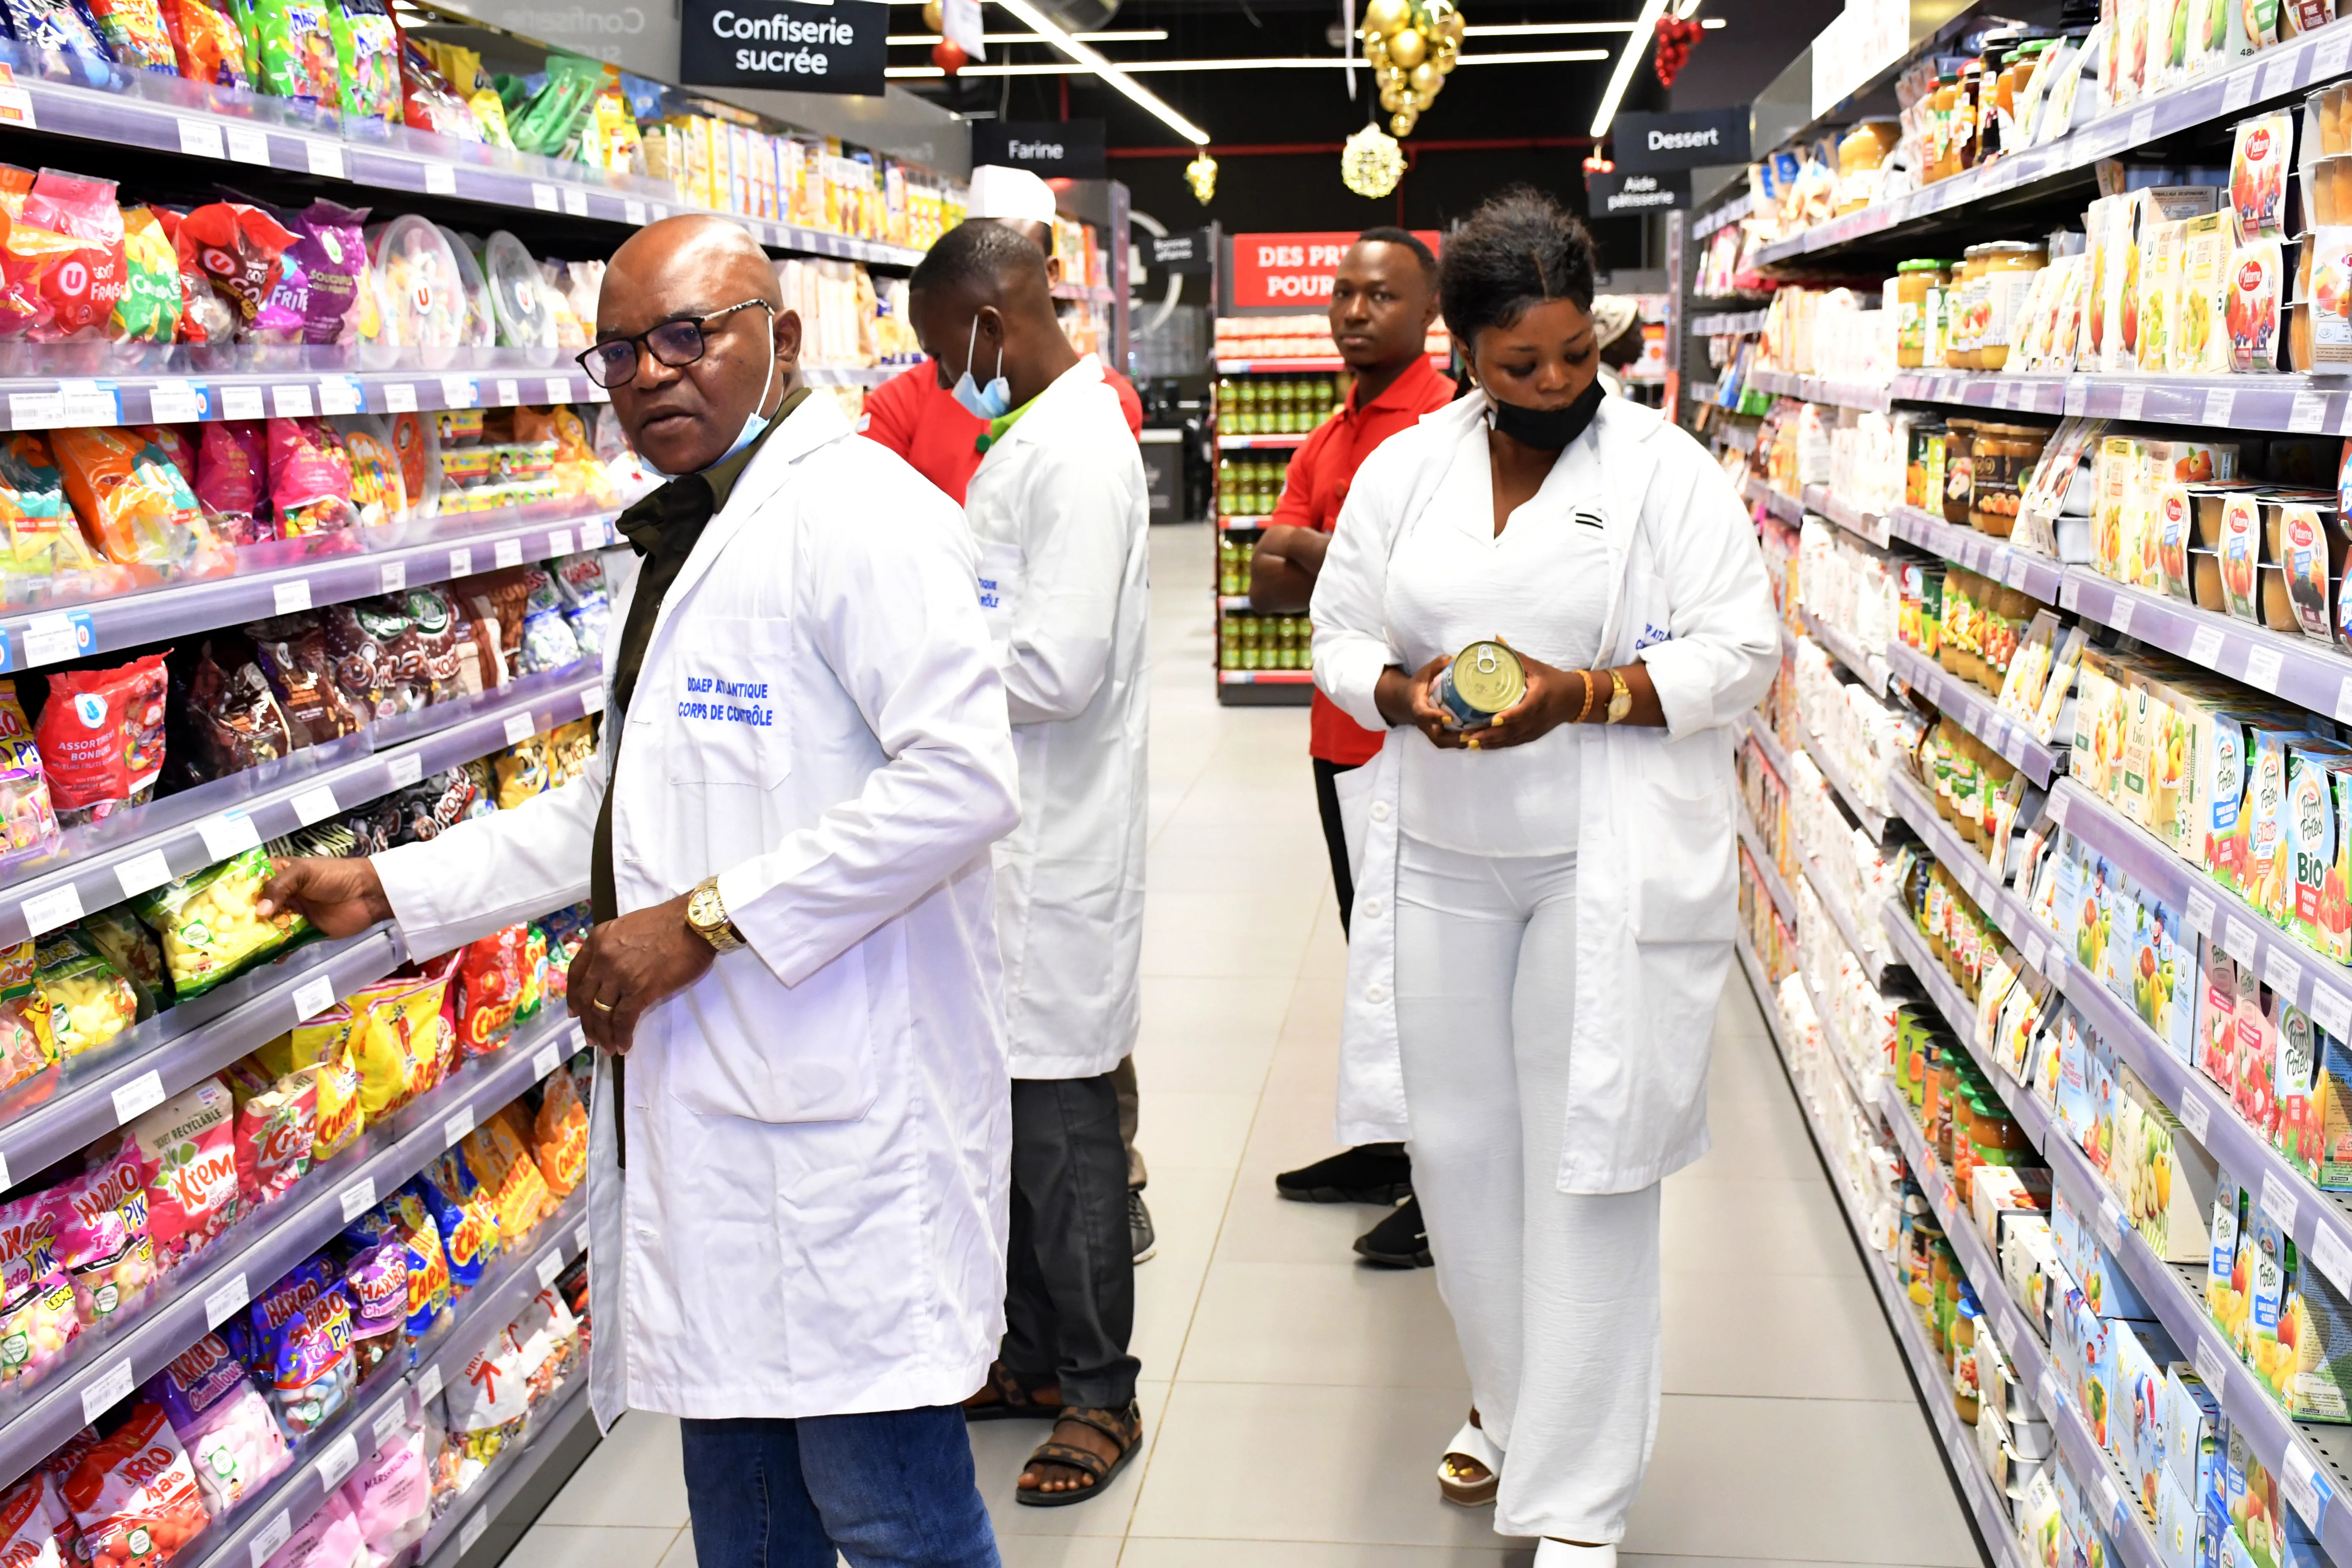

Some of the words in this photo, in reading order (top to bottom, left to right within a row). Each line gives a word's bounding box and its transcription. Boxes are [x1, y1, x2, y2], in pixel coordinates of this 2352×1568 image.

[713, 9, 854, 46] Confiserie
[736, 46, 828, 75] sucrée
[1008, 139, 1064, 159] Farine
[1648, 128, 1719, 151] Dessert
[1624, 175, 1657, 192] Aide
[1607, 189, 1675, 211] pâtisserie
[1258, 246, 1303, 268] DES
[65, 270, 82, 289] U
[1268, 275, 1335, 297] POUR
[418, 287, 428, 306] U
[79, 631, 87, 642] U
[687, 677, 712, 693] DDAEP
[715, 679, 768, 698] ATLANTIQUE
[678, 701, 707, 720] CORPS
[710, 704, 724, 720] DE
[727, 705, 773, 726] CONTRÔLE
[2139, 694, 2147, 715] U
[2297, 852, 2323, 888] Bio
[171, 1108, 223, 1139] RECYCLABLE
[44, 1284, 74, 1311] LEMO
[190, 1361, 244, 1410] Chamallows
